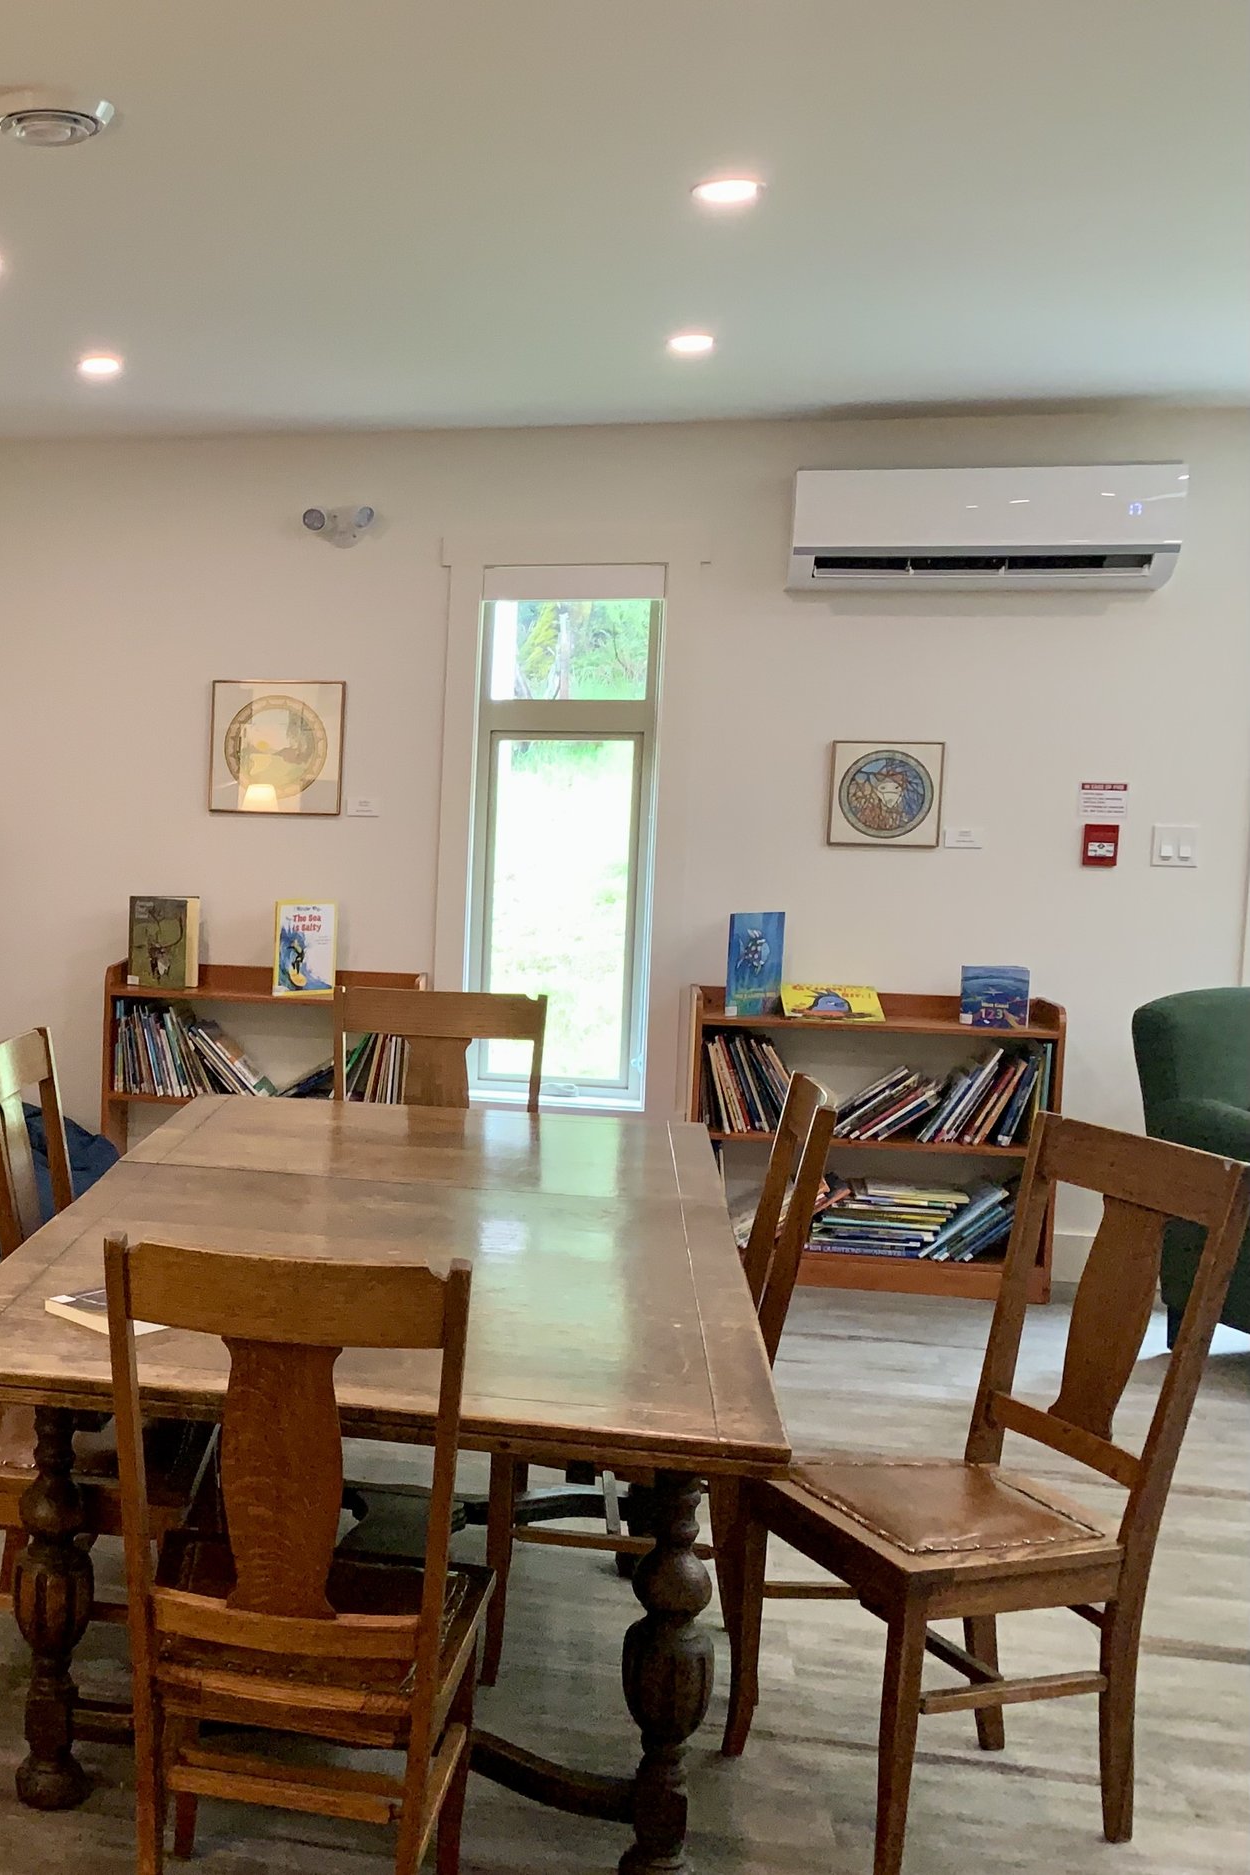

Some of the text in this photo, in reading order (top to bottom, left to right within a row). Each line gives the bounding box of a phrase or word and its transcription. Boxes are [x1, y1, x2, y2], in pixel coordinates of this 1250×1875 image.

[293, 914, 322, 922] The Sea
[301, 924, 322, 933] Salty
